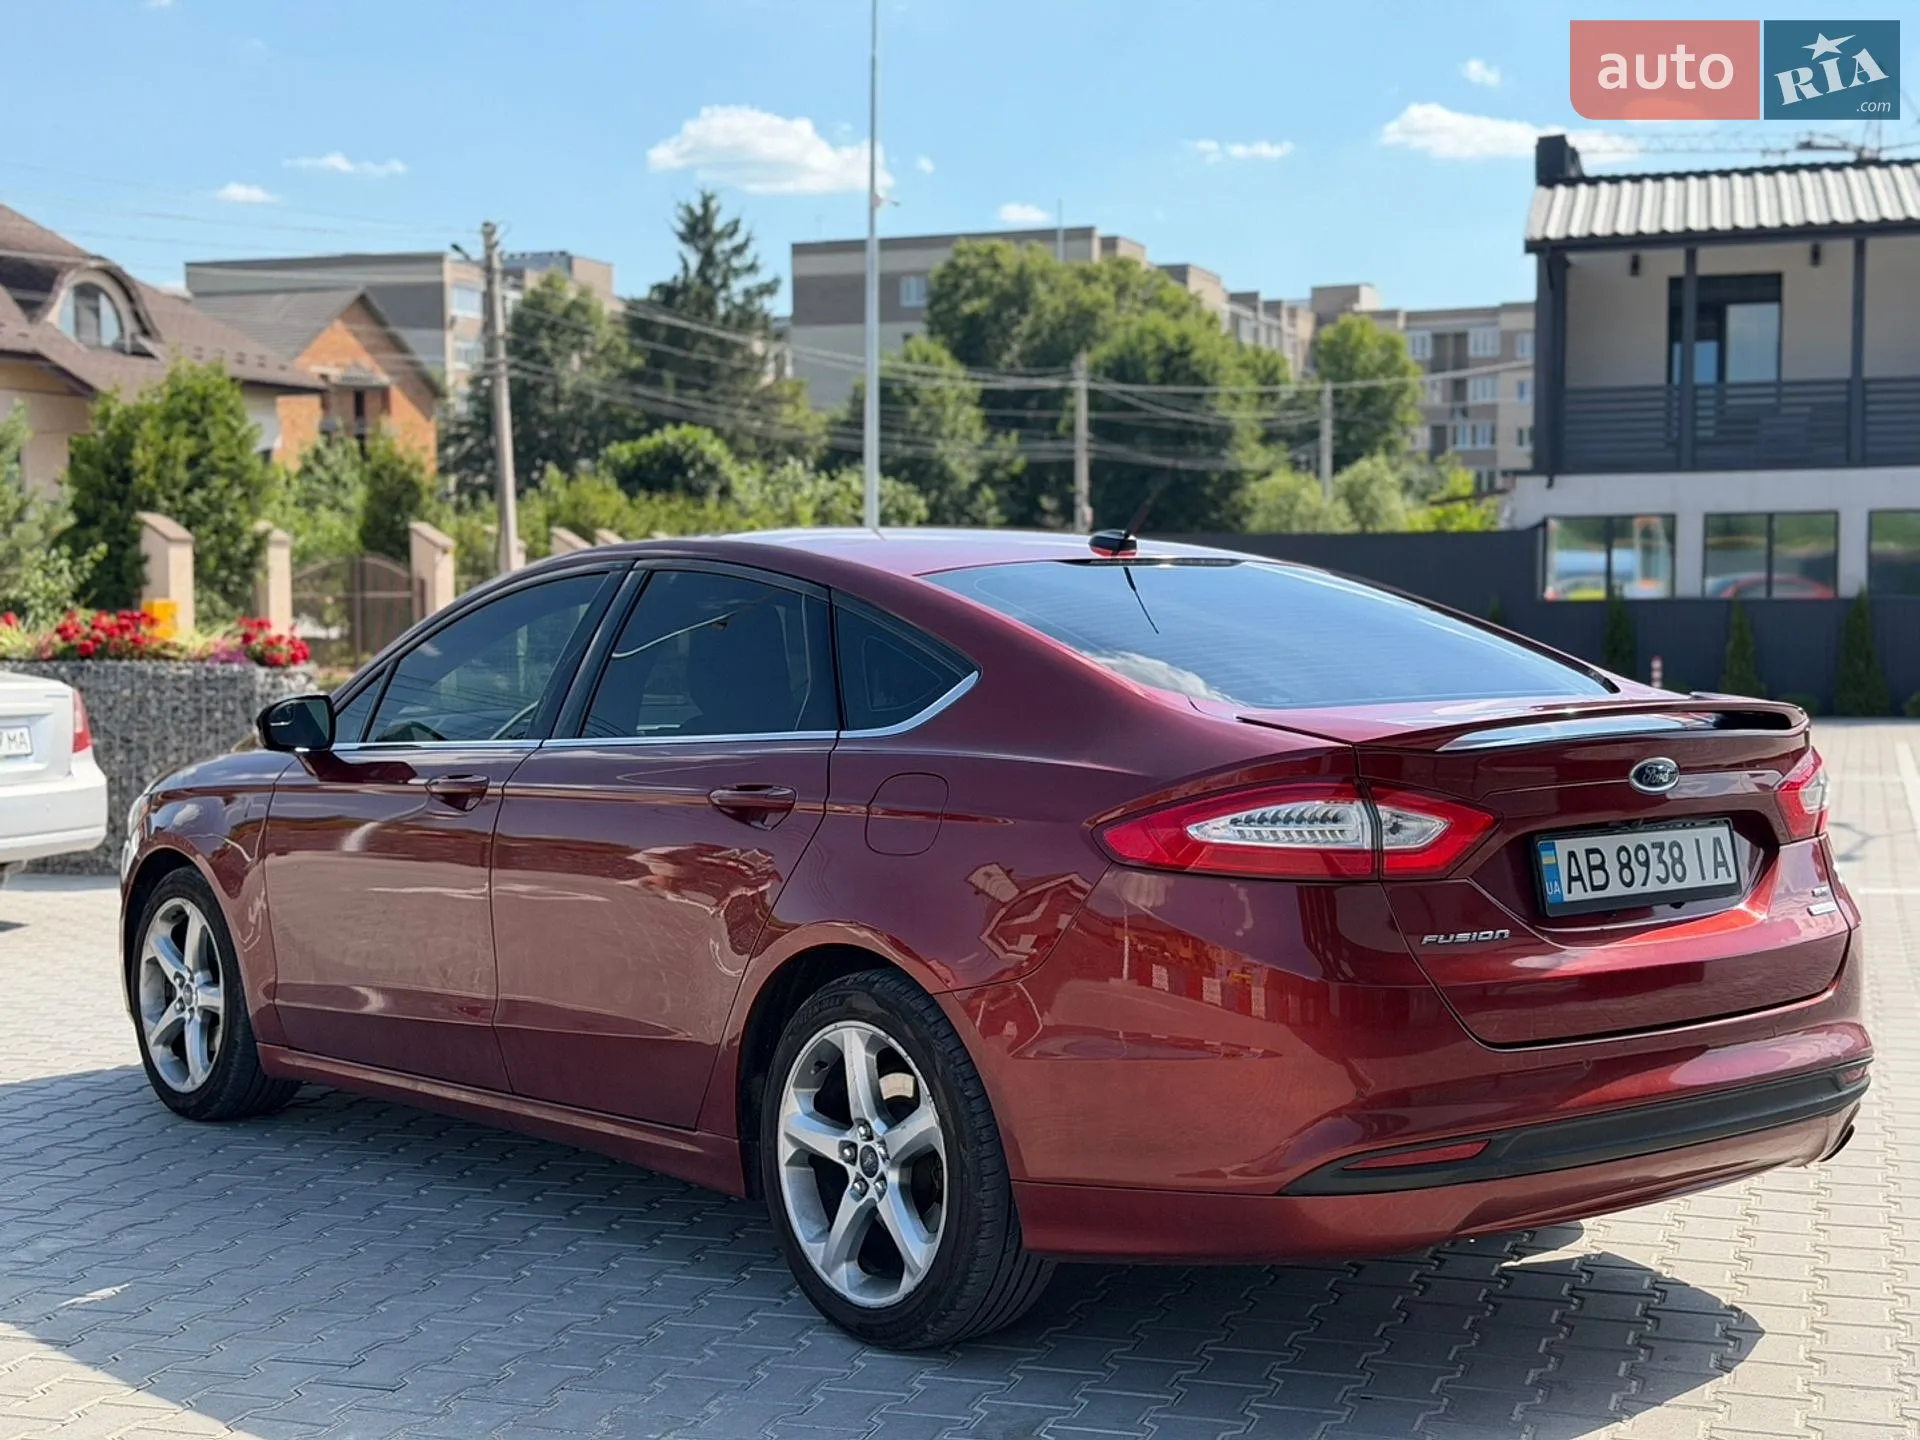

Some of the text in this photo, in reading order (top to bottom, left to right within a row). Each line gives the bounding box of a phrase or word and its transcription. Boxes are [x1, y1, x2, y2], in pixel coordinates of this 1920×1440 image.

[1566, 836, 1732, 894] AB 8938 IA
[1546, 880, 1561, 895] UA
[1421, 929, 1511, 945] FUSION
